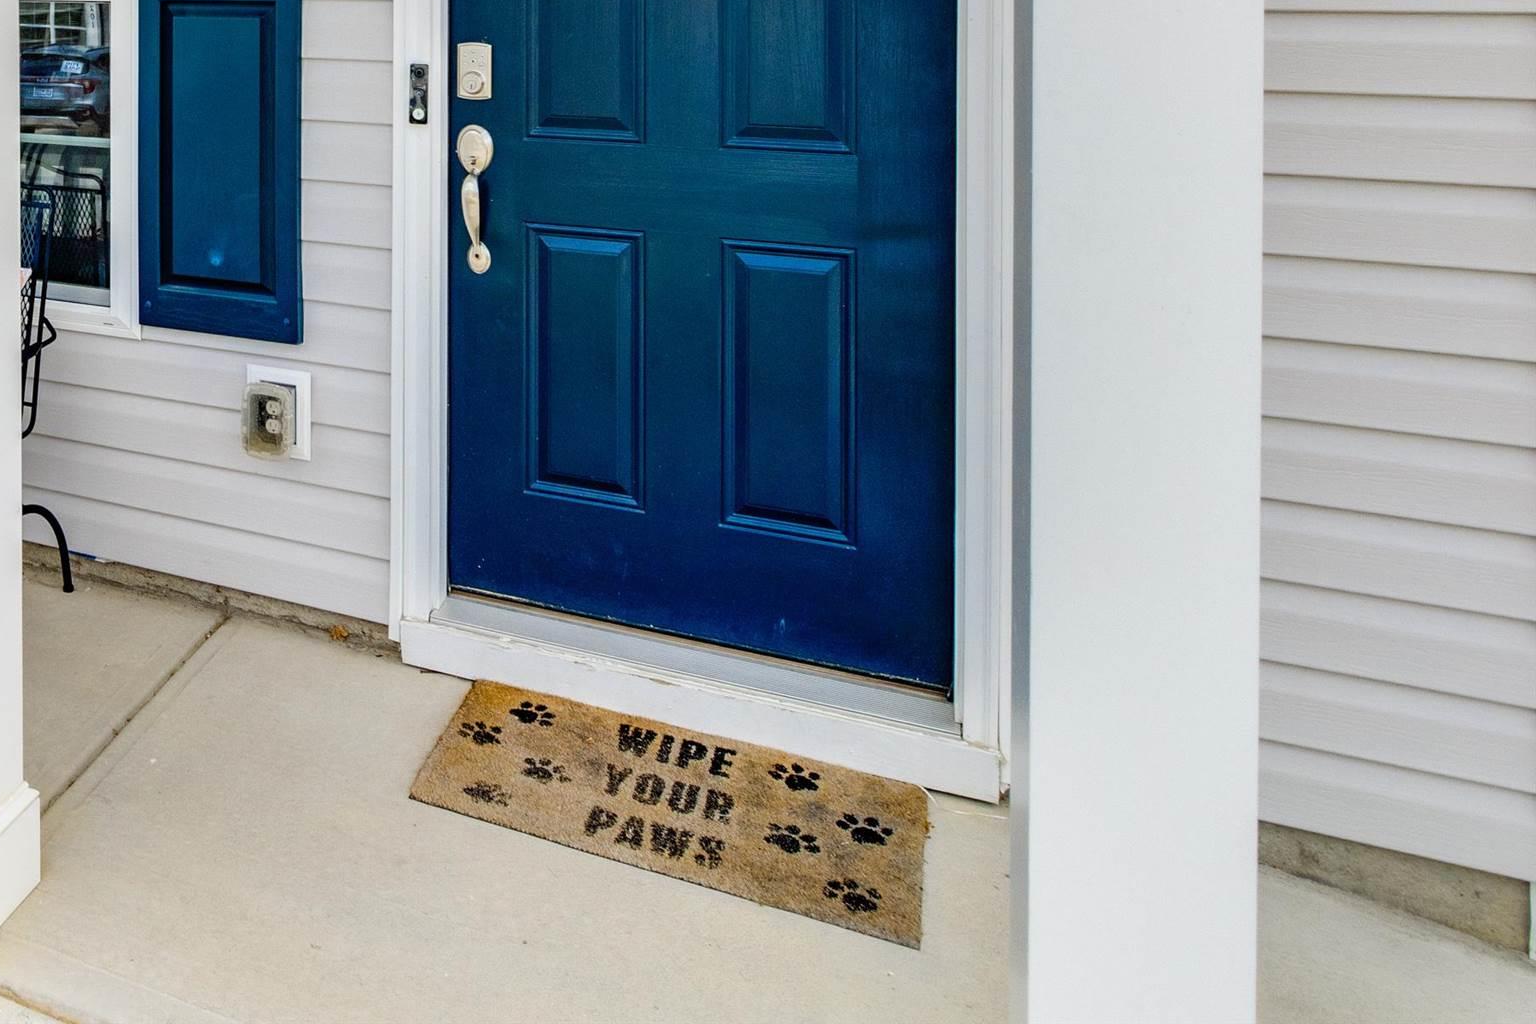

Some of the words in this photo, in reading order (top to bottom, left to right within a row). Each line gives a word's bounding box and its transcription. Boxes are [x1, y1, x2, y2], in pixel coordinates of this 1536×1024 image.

[617, 723, 737, 779] WIPE
[604, 762, 735, 825] YOUR
[583, 805, 726, 870] PAWS
